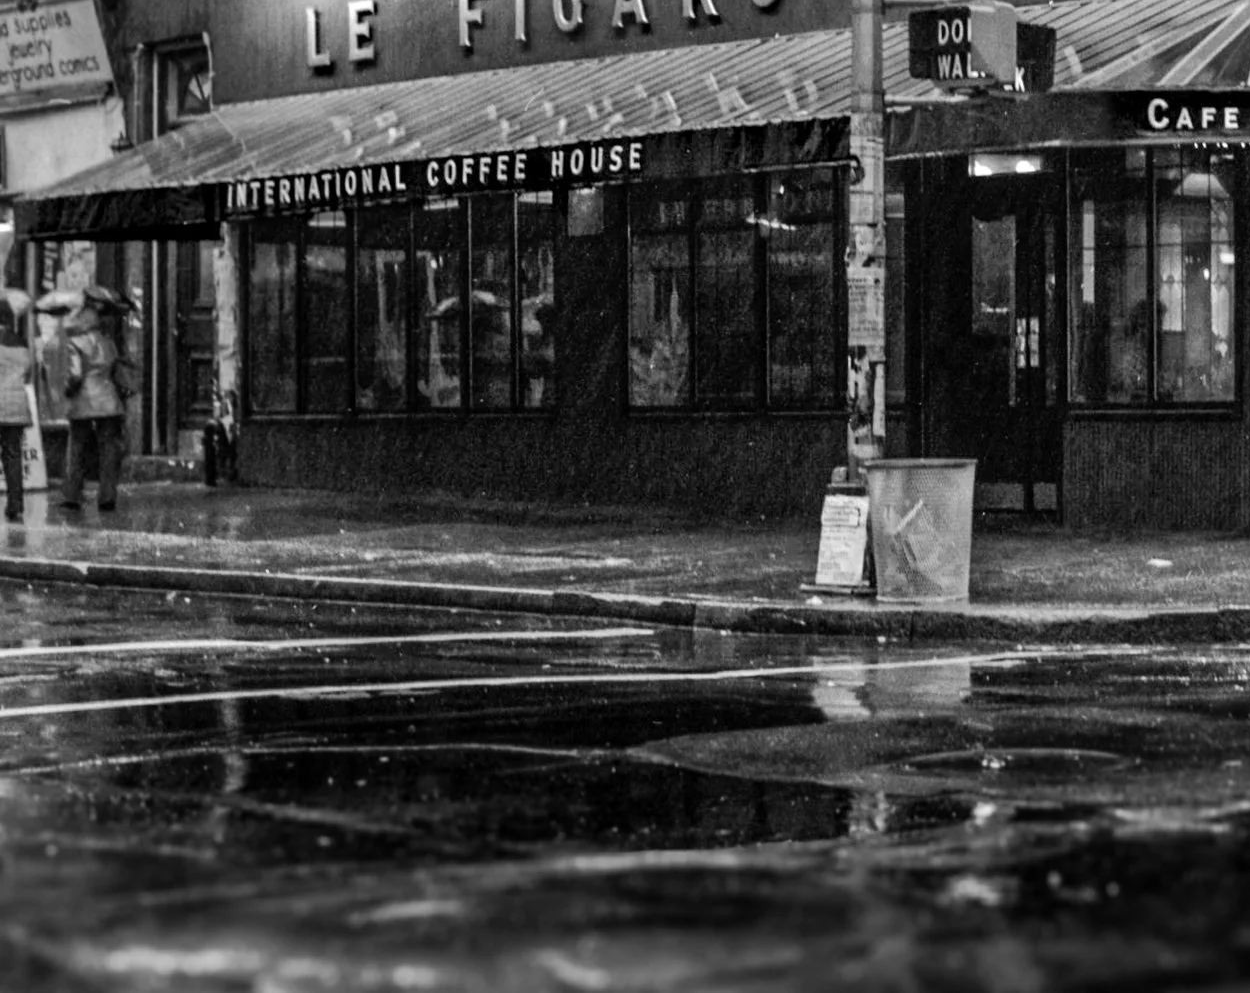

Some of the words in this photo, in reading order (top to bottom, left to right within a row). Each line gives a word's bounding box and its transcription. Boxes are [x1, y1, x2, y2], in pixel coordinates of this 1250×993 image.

[1147, 97, 1240, 130] CAFE
[227, 164, 407, 208] INTERNATIONAL
[426, 152, 528, 187] COFFEE
[550, 141, 643, 179] HOUSE
